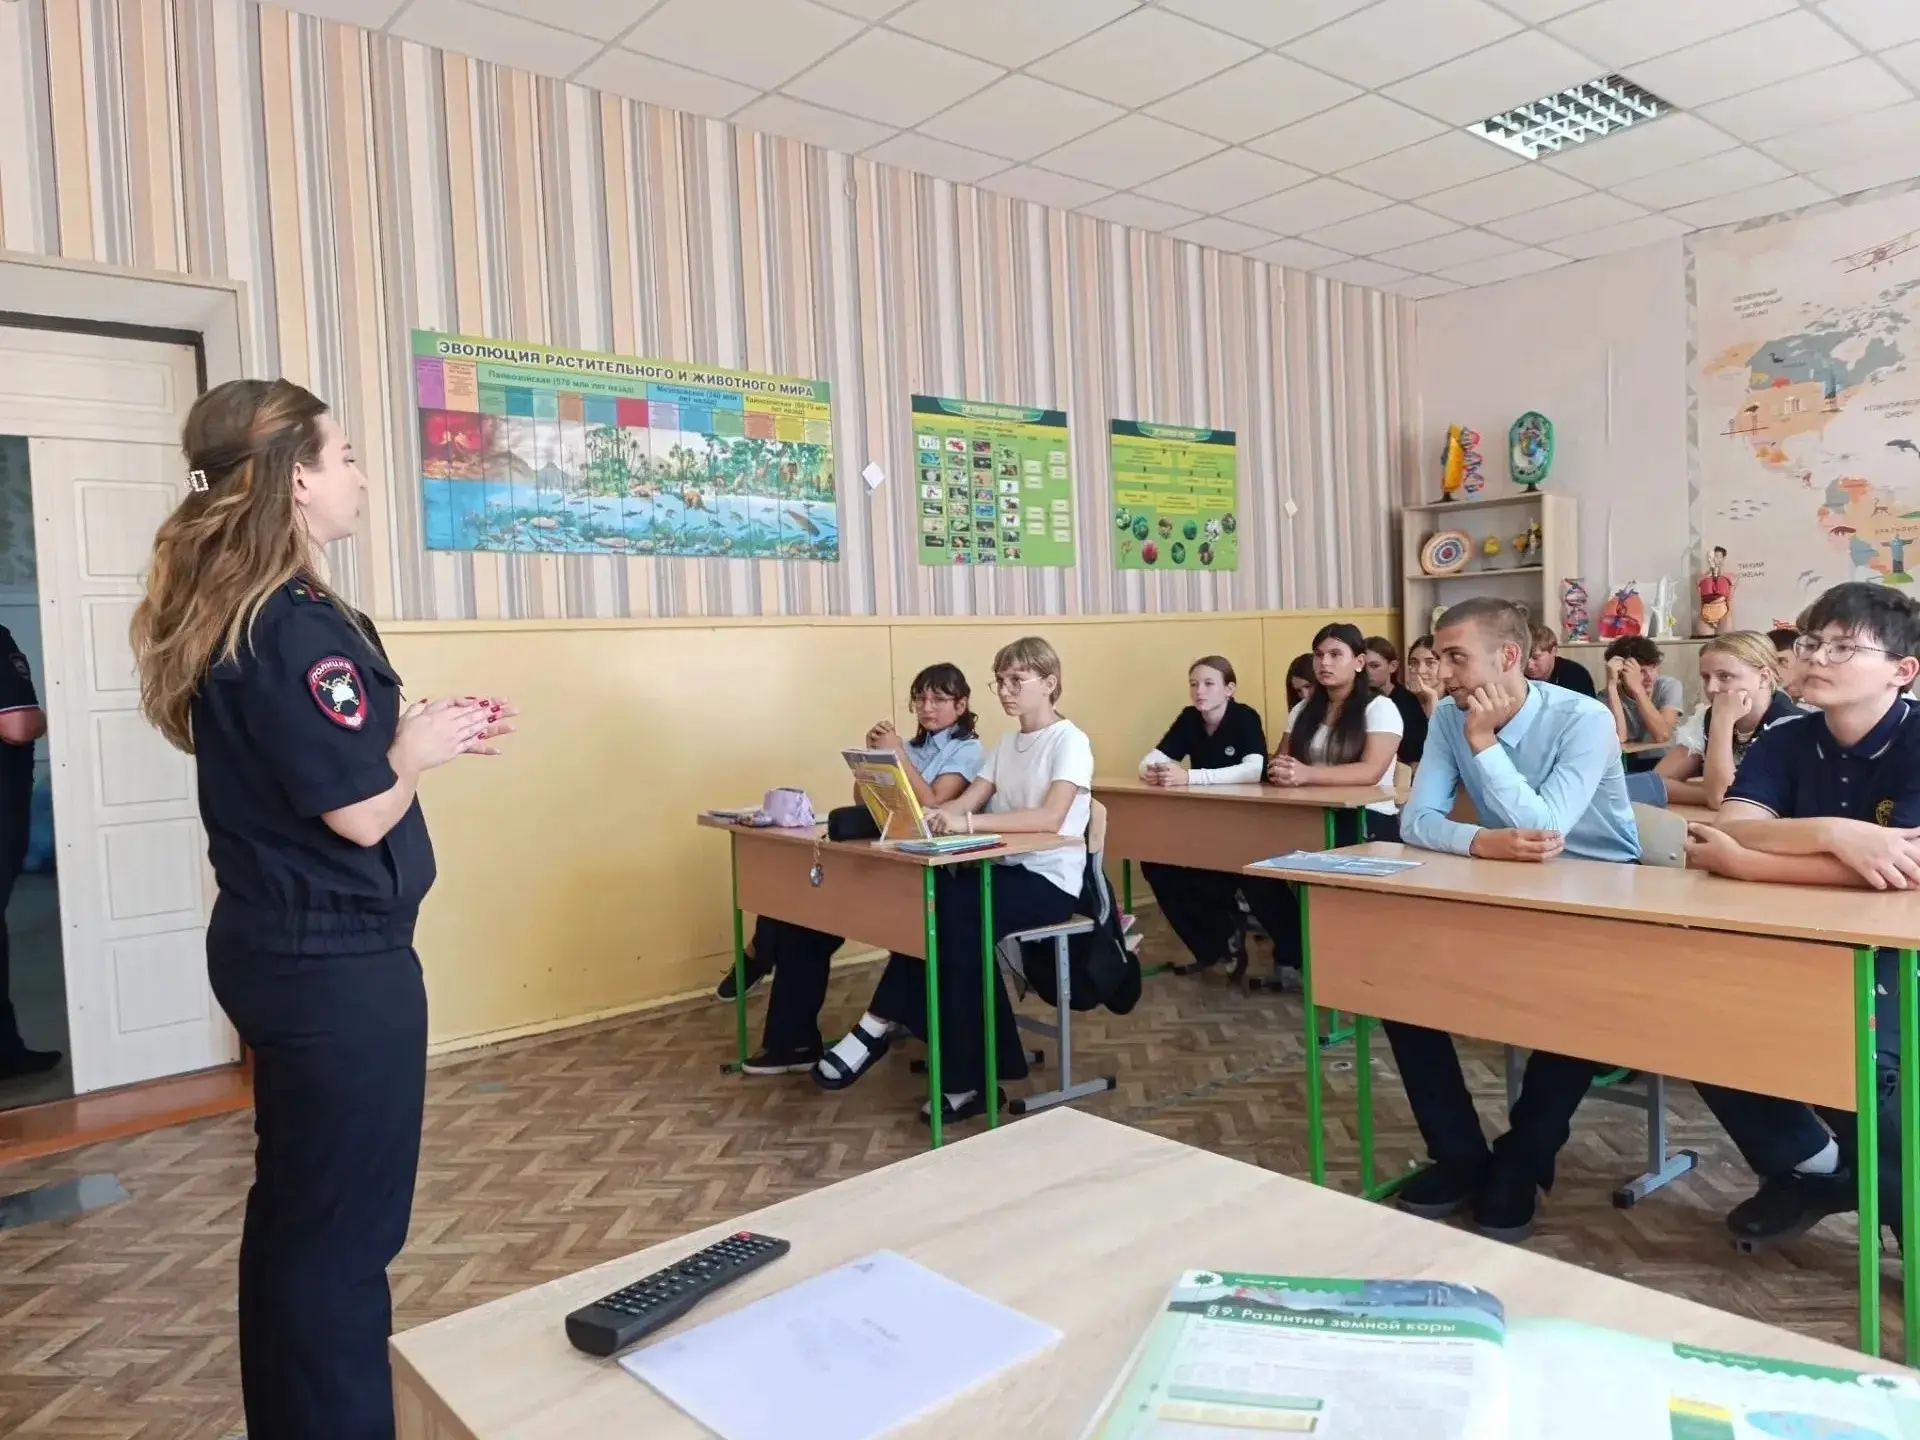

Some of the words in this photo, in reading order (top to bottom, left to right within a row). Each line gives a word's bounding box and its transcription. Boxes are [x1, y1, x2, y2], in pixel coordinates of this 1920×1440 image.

[440, 341, 540, 363] ЭВОЛЮЦИЯ
[545, 354, 674, 380] РАСТИТЕЛЬНОГО
[678, 370, 688, 381] И
[693, 372, 776, 393] ЖИВОТНОГО
[779, 384, 814, 397] МИРА
[311, 660, 353, 684] ПОЛИЦИЯ
[1241, 1307, 1325, 1326] Развитие
[1330, 1319, 1401, 1331] земной
[1405, 1322, 1456, 1334] коры
